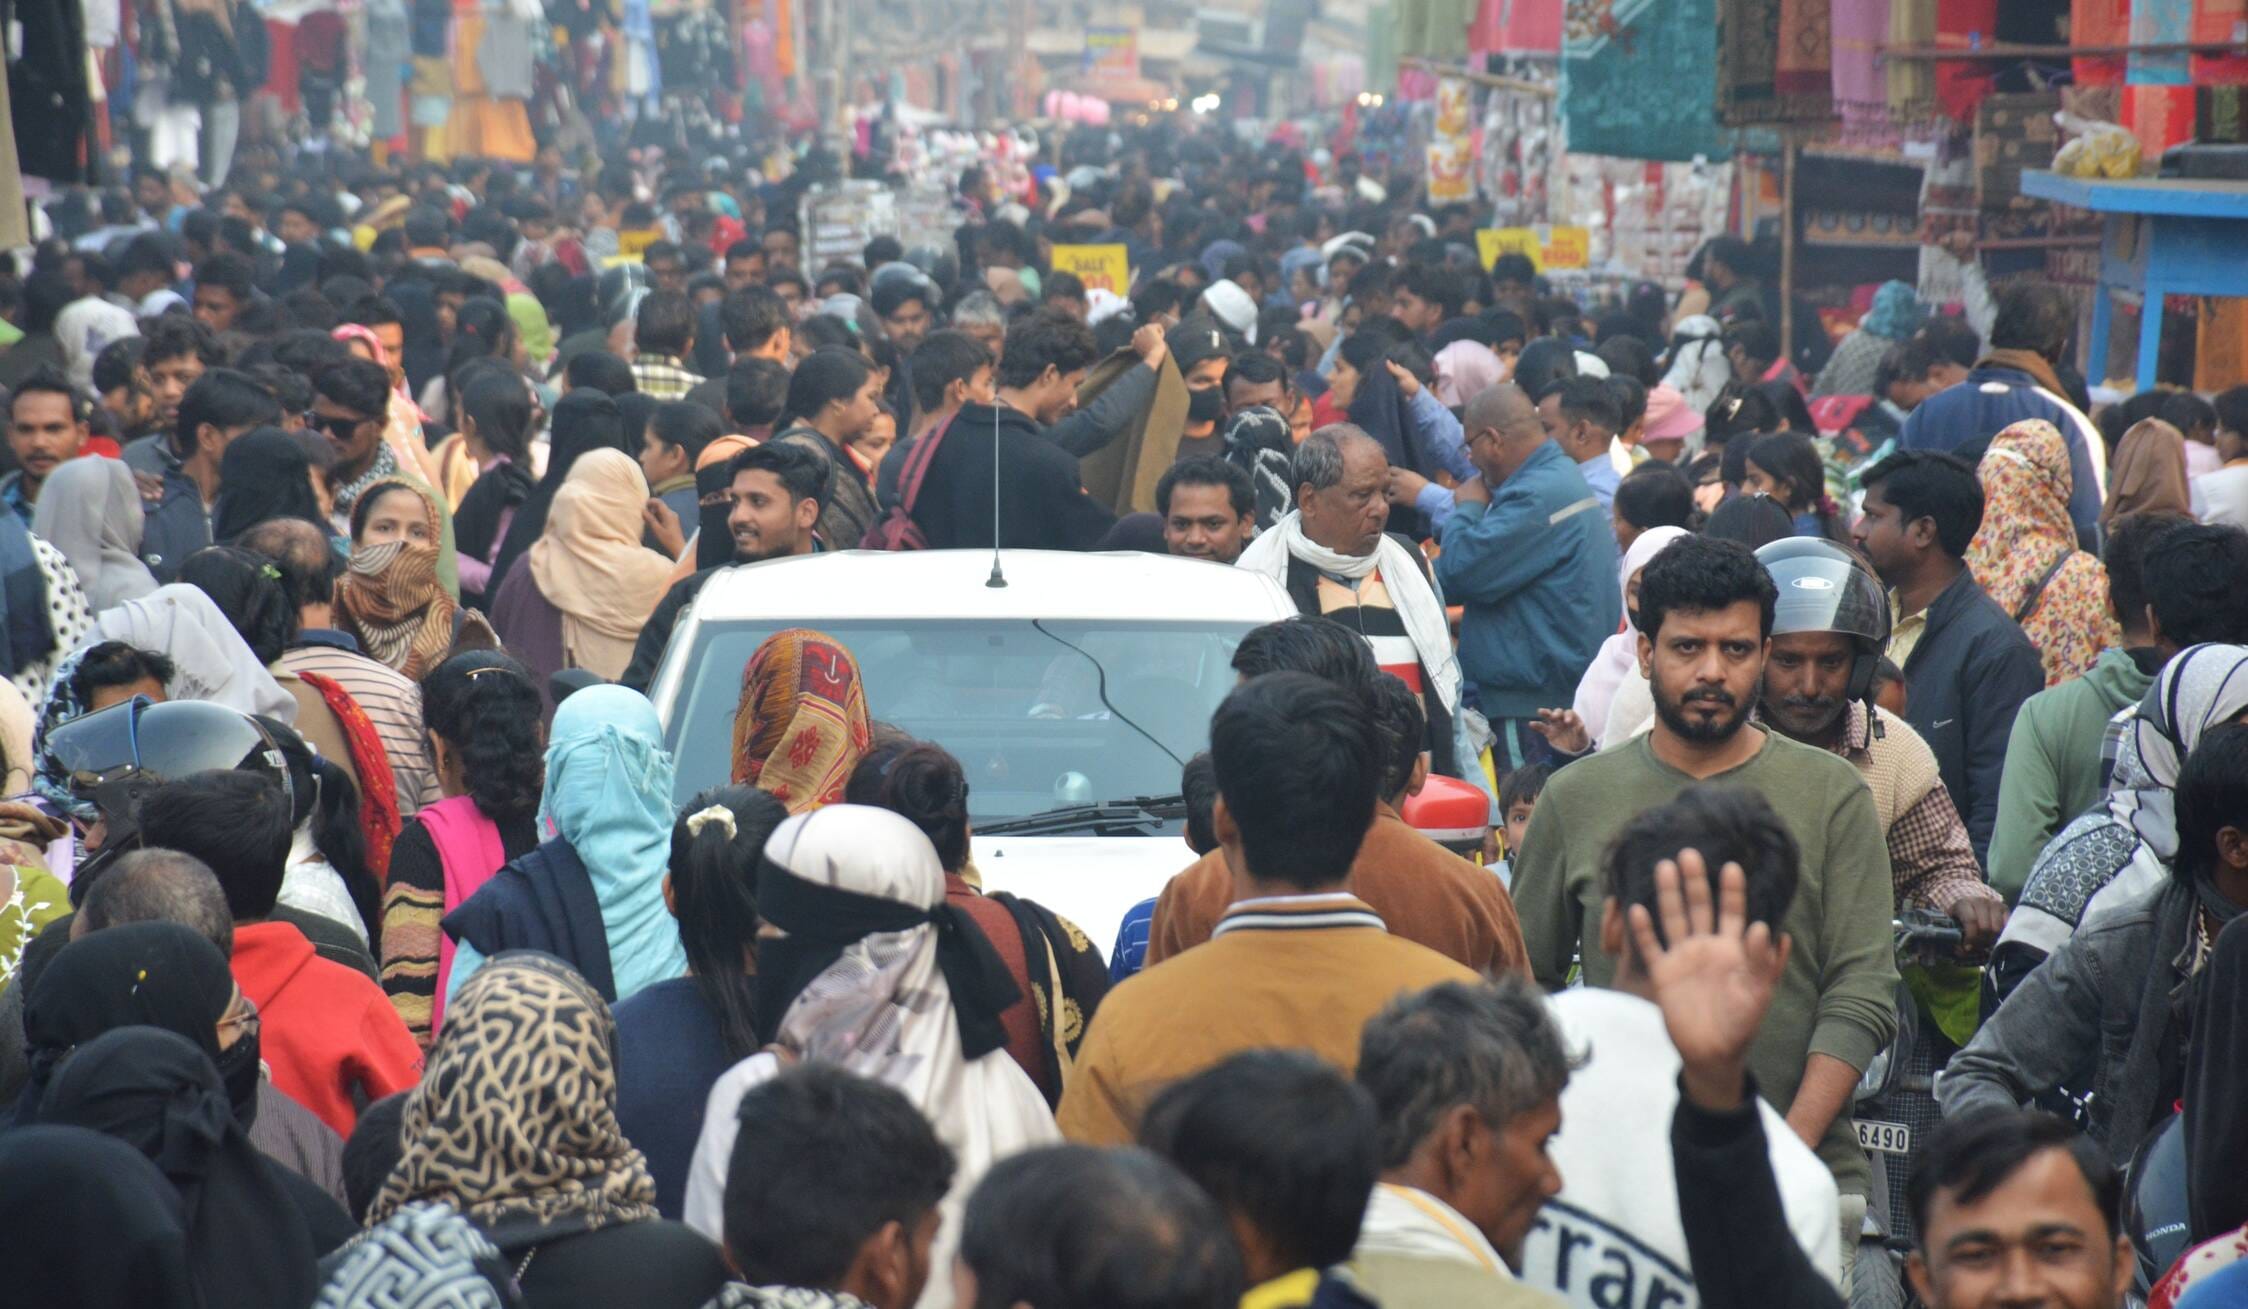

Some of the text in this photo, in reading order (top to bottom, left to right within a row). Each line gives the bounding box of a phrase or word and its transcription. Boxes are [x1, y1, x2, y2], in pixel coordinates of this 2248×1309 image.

[1074, 257, 1106, 272] SALE
[1859, 1124, 1905, 1150] 6490
[2145, 1222, 2186, 1241] HONDA
